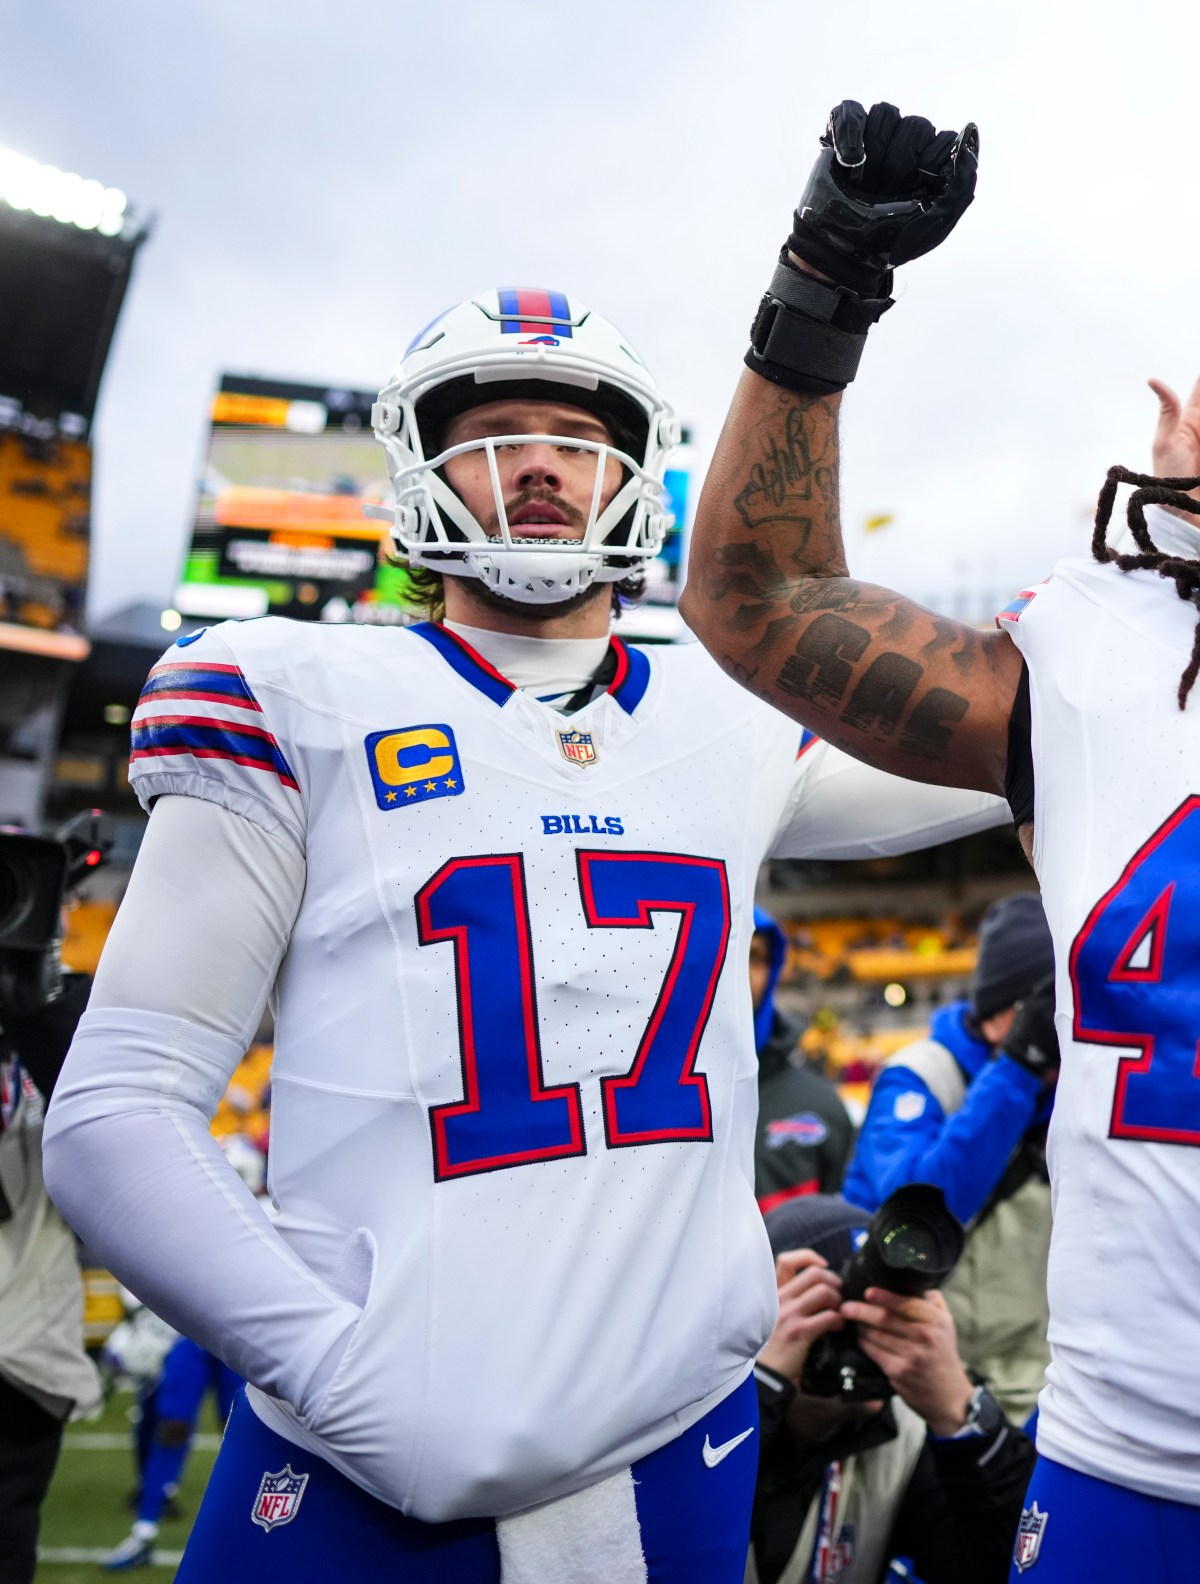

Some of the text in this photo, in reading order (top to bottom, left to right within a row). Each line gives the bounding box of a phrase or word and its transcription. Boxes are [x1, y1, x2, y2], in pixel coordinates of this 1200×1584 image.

[375, 728, 454, 787] C
[565, 744, 593, 760] NFL
[540, 814, 625, 836] BILLS
[414, 848, 731, 1183] 17
[258, 1495, 290, 1520] NFL
